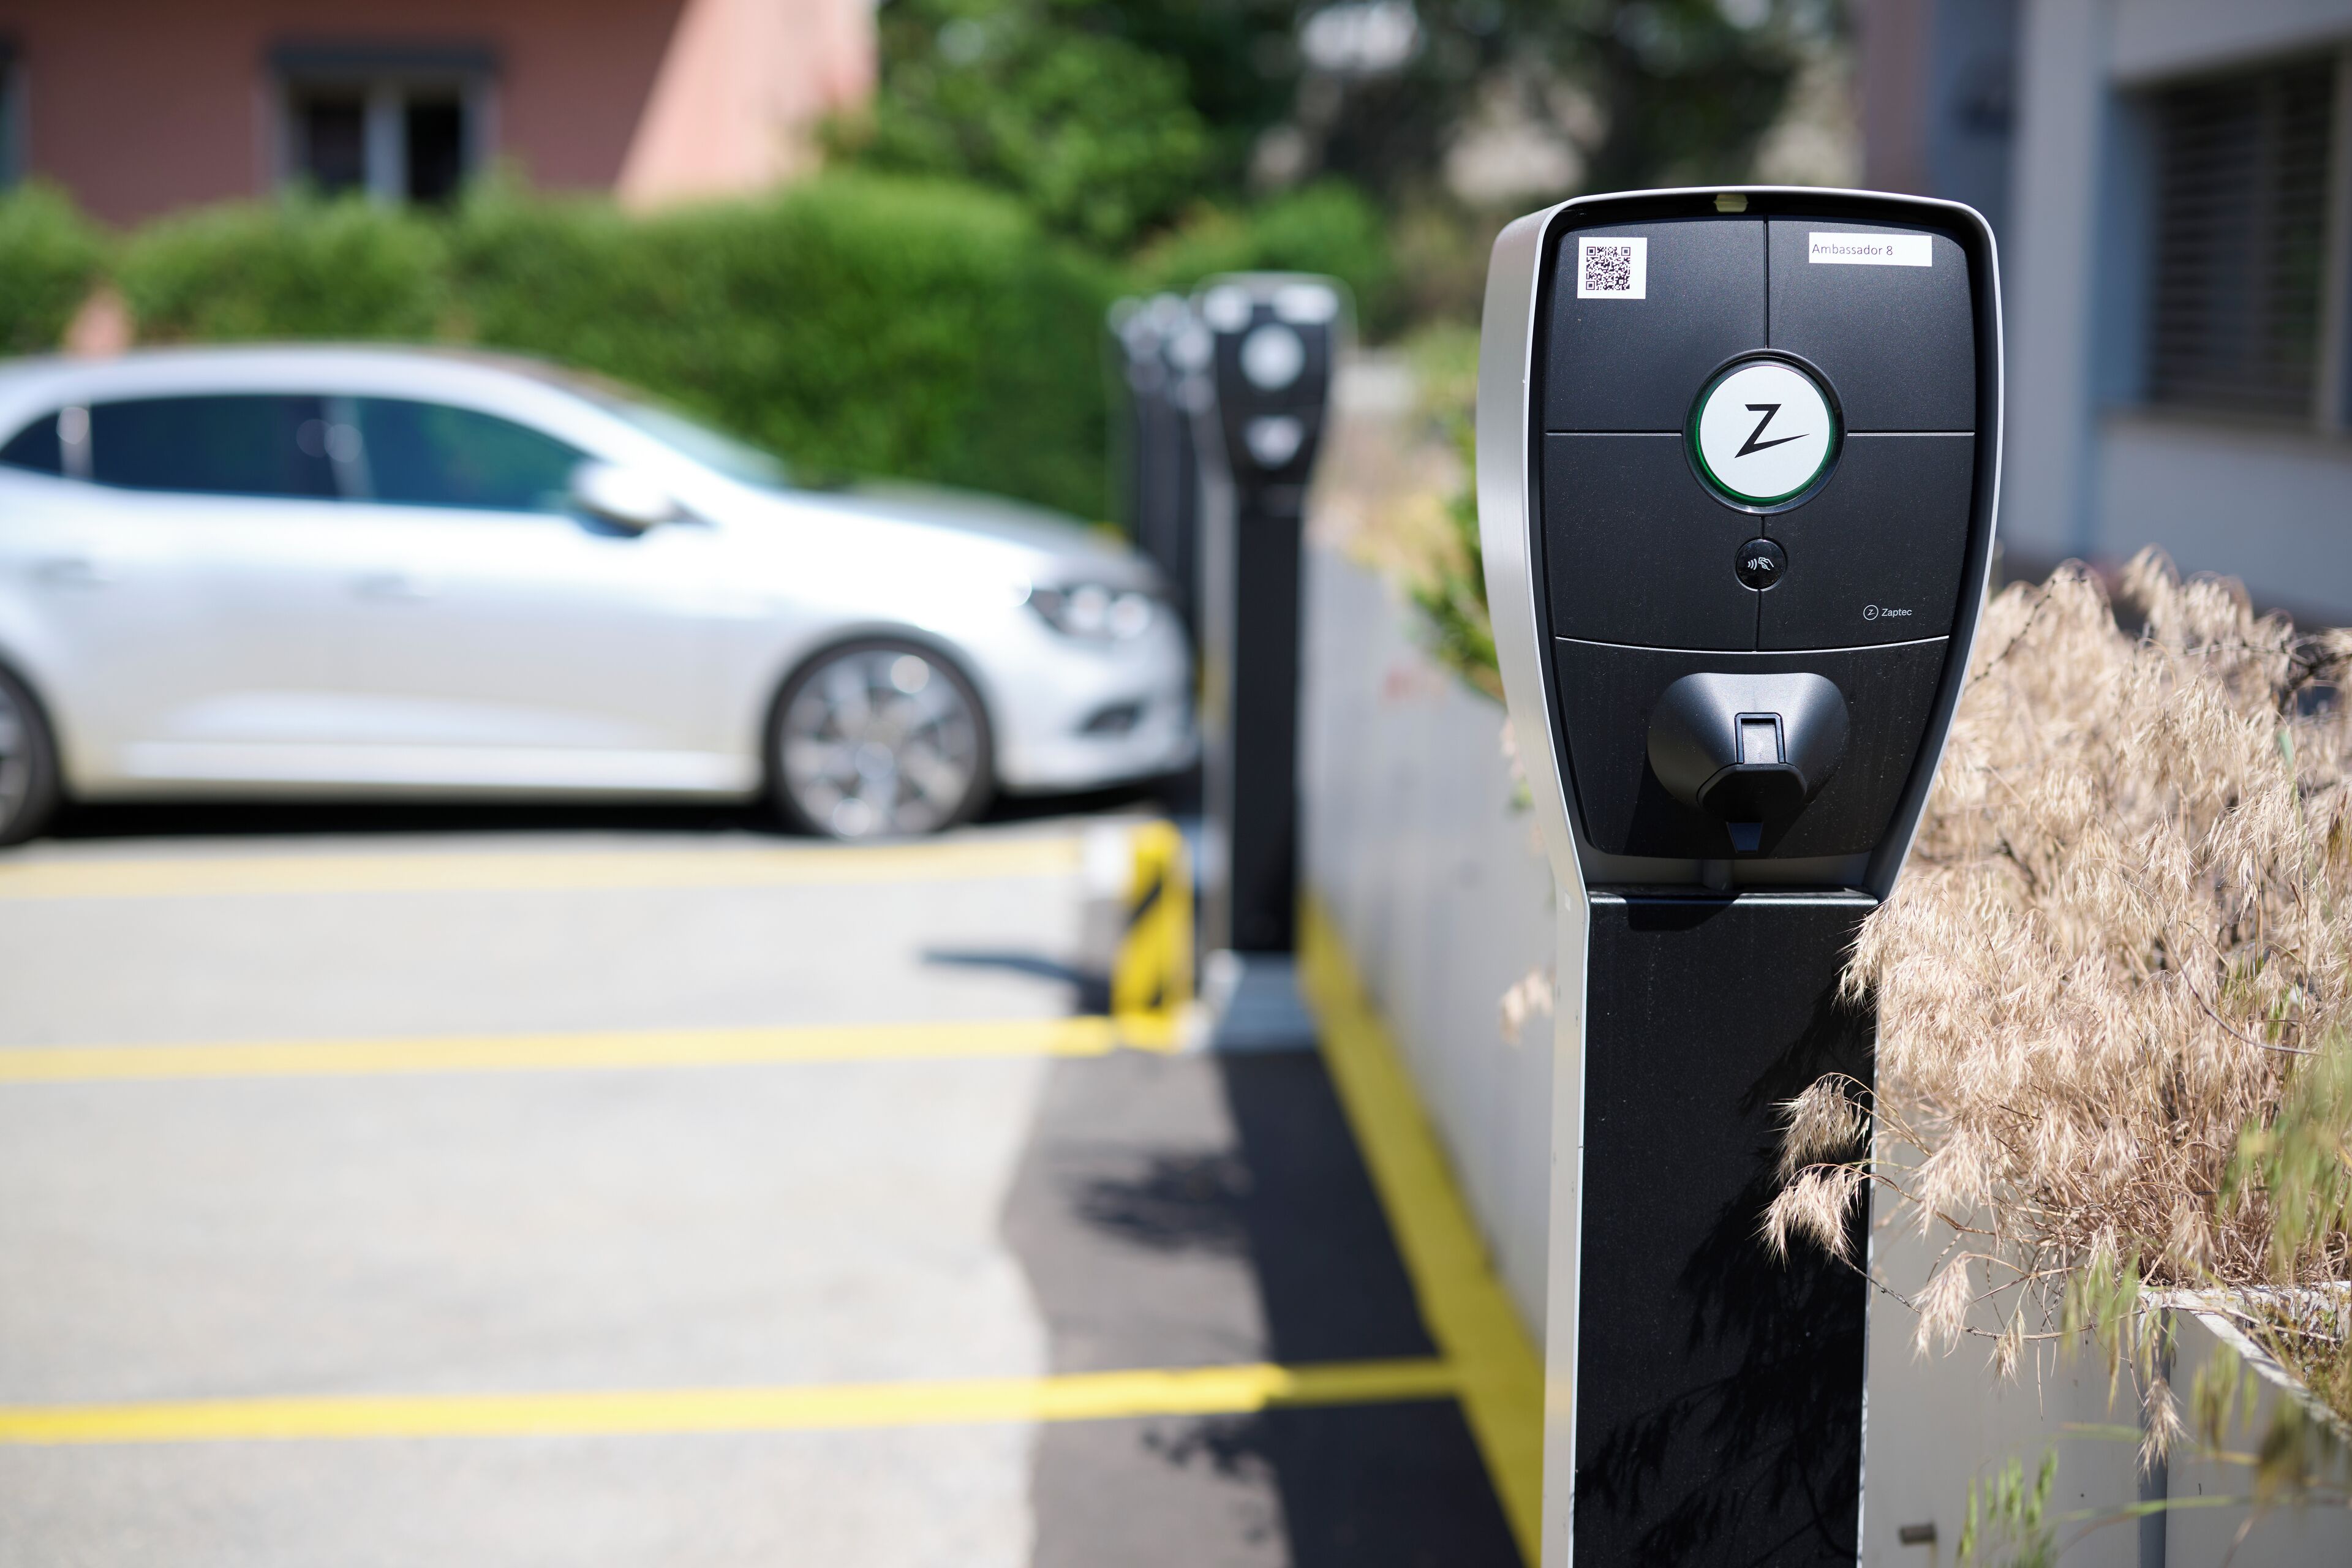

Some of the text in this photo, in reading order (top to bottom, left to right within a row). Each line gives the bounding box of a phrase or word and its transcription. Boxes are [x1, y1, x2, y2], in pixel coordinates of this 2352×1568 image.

[1812, 244, 1893, 255] Ambassador 8
[1734, 404, 1811, 459] Z
[1881, 608, 1912, 617] Zaptec
